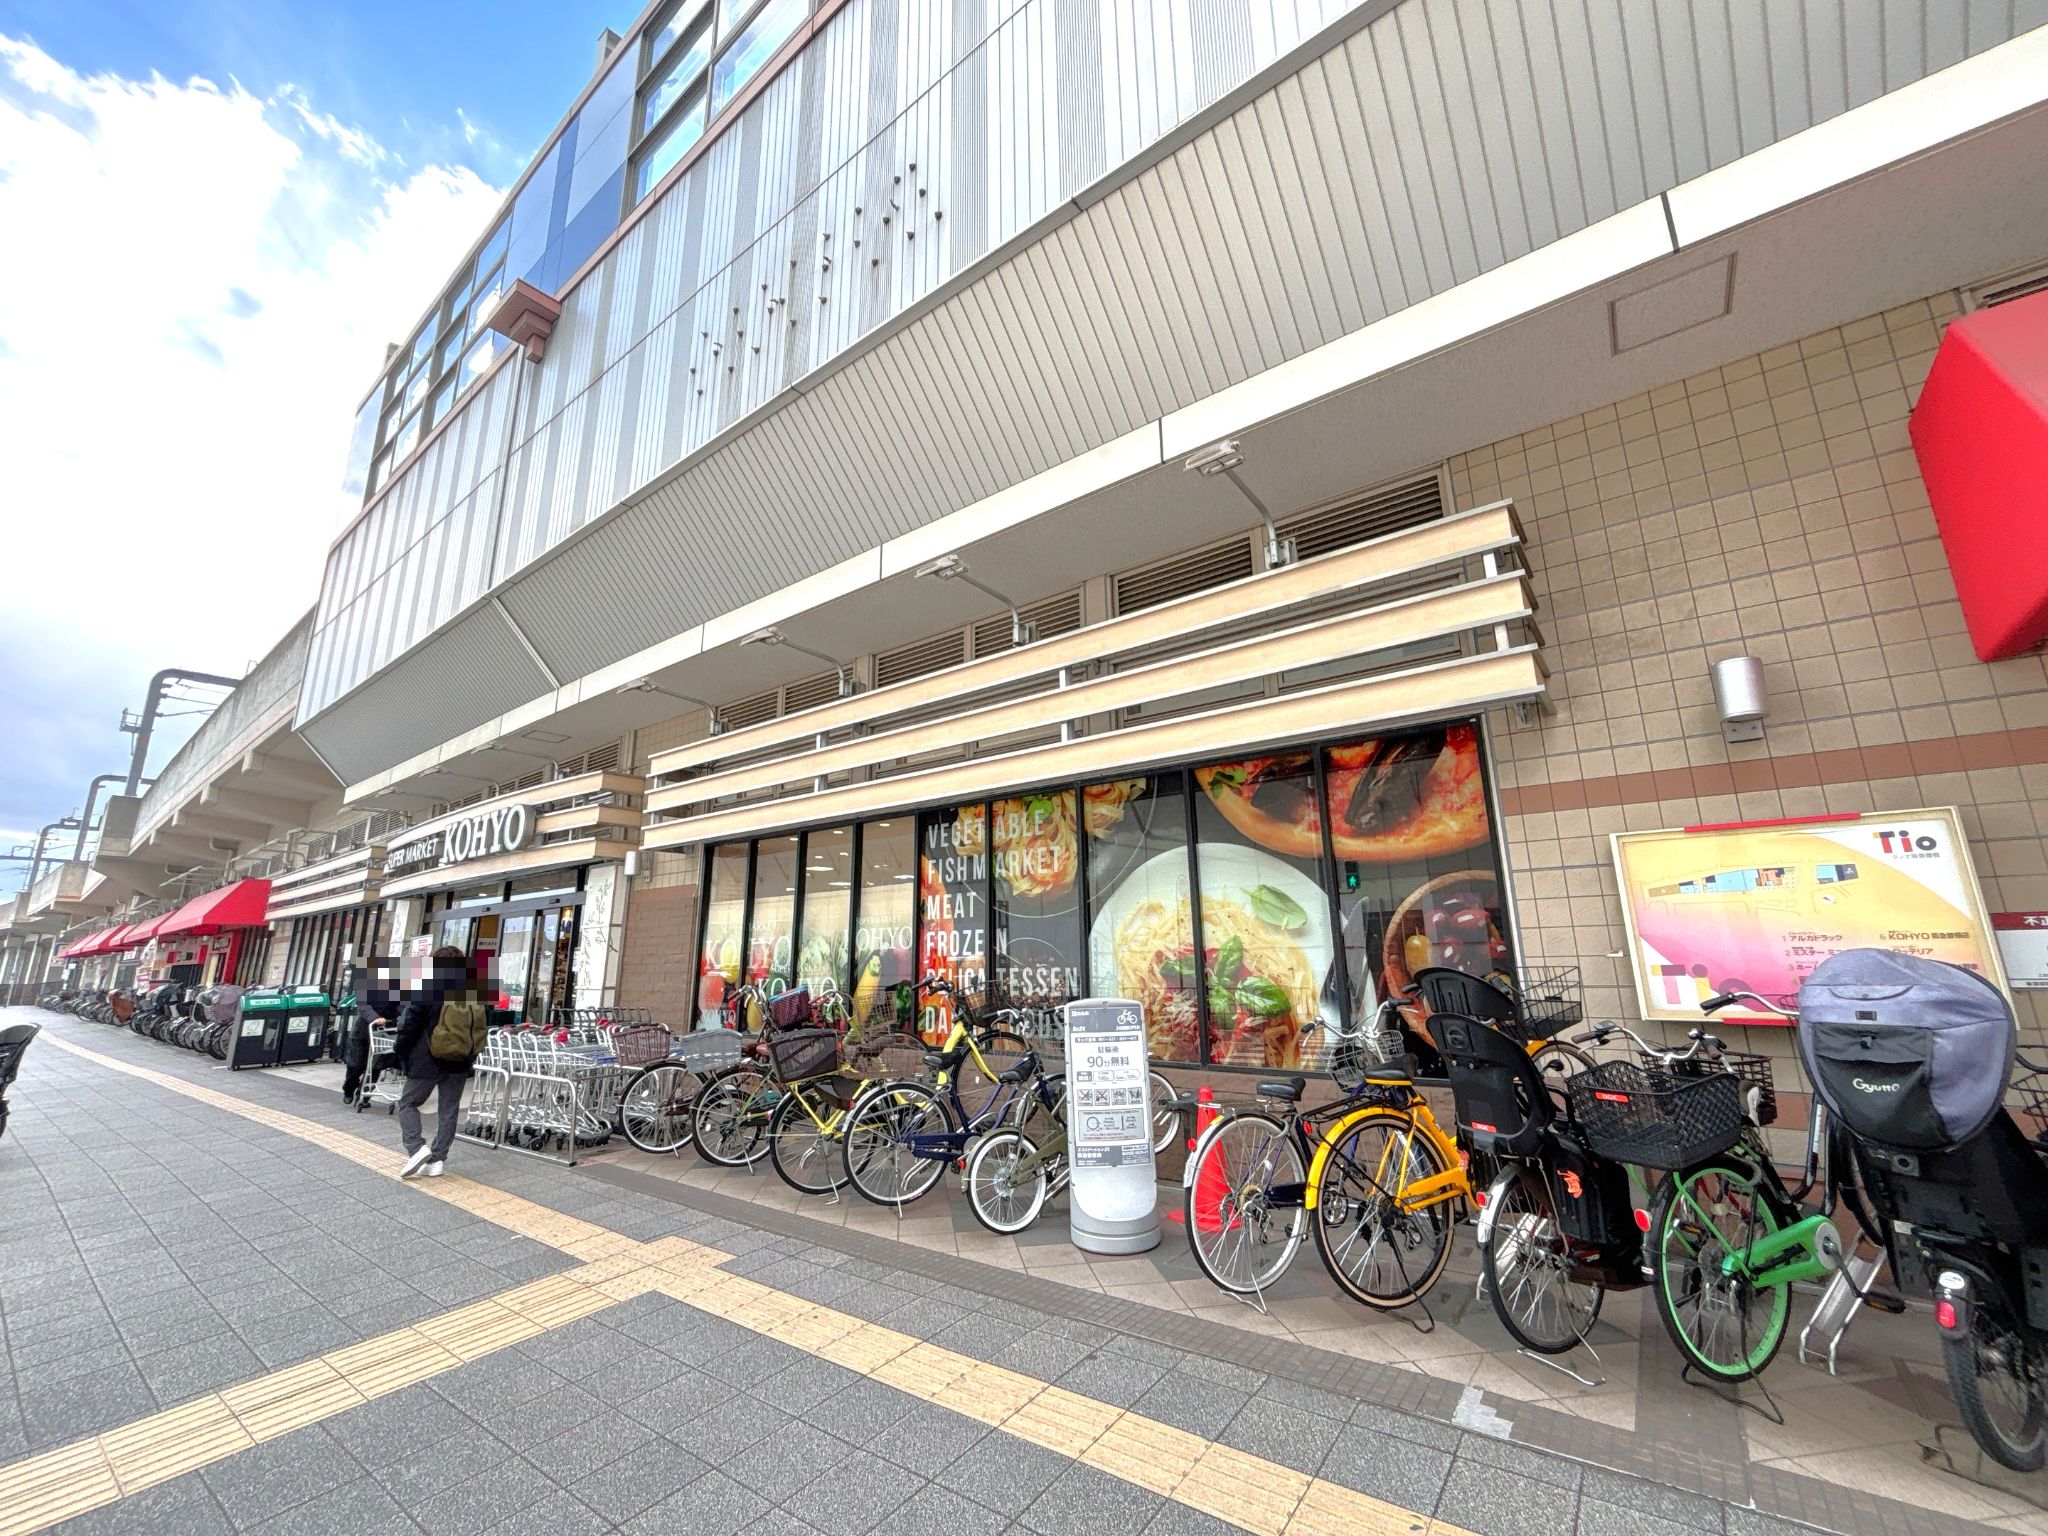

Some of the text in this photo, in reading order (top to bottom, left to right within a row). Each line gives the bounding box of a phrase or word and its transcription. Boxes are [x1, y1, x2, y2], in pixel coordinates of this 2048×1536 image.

[442, 803, 526, 864] KOHYO
[1873, 829, 1937, 853] Tio
[388, 837, 439, 869] SUPER MARKET
[927, 844, 1062, 885] FISH MARKET
[926, 891, 977, 921] MEAT
[925, 928, 1008, 957] FROZEN
[1888, 932, 1930, 940] KOHYO
[1852, 1077, 1901, 1093] Gyutto
